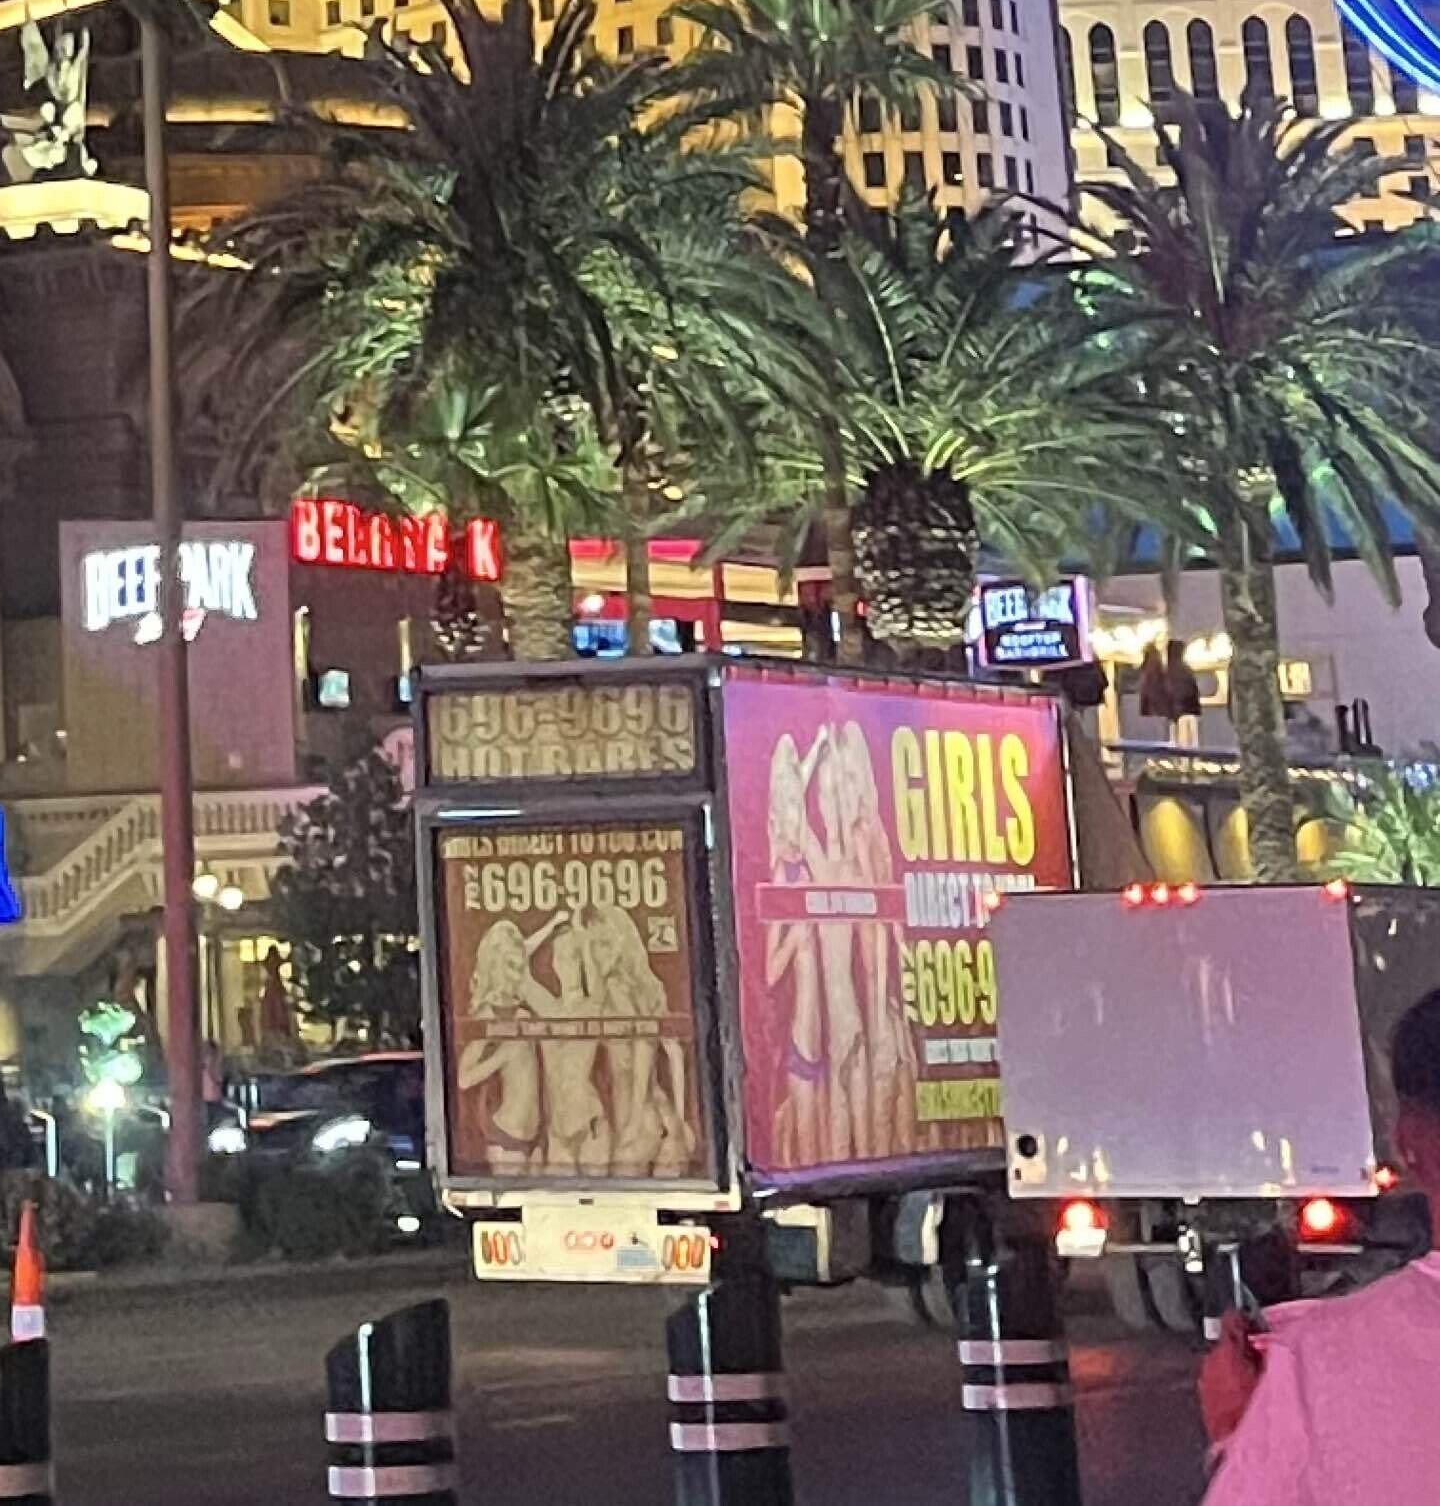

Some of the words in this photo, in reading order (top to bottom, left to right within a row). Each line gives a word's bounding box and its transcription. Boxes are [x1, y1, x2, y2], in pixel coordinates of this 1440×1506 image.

[438, 684, 693, 741] 696-9696
[891, 725, 1035, 867] GIRLS
[481, 857, 669, 913] 696-9696
[916, 938, 998, 1027] 696-9
